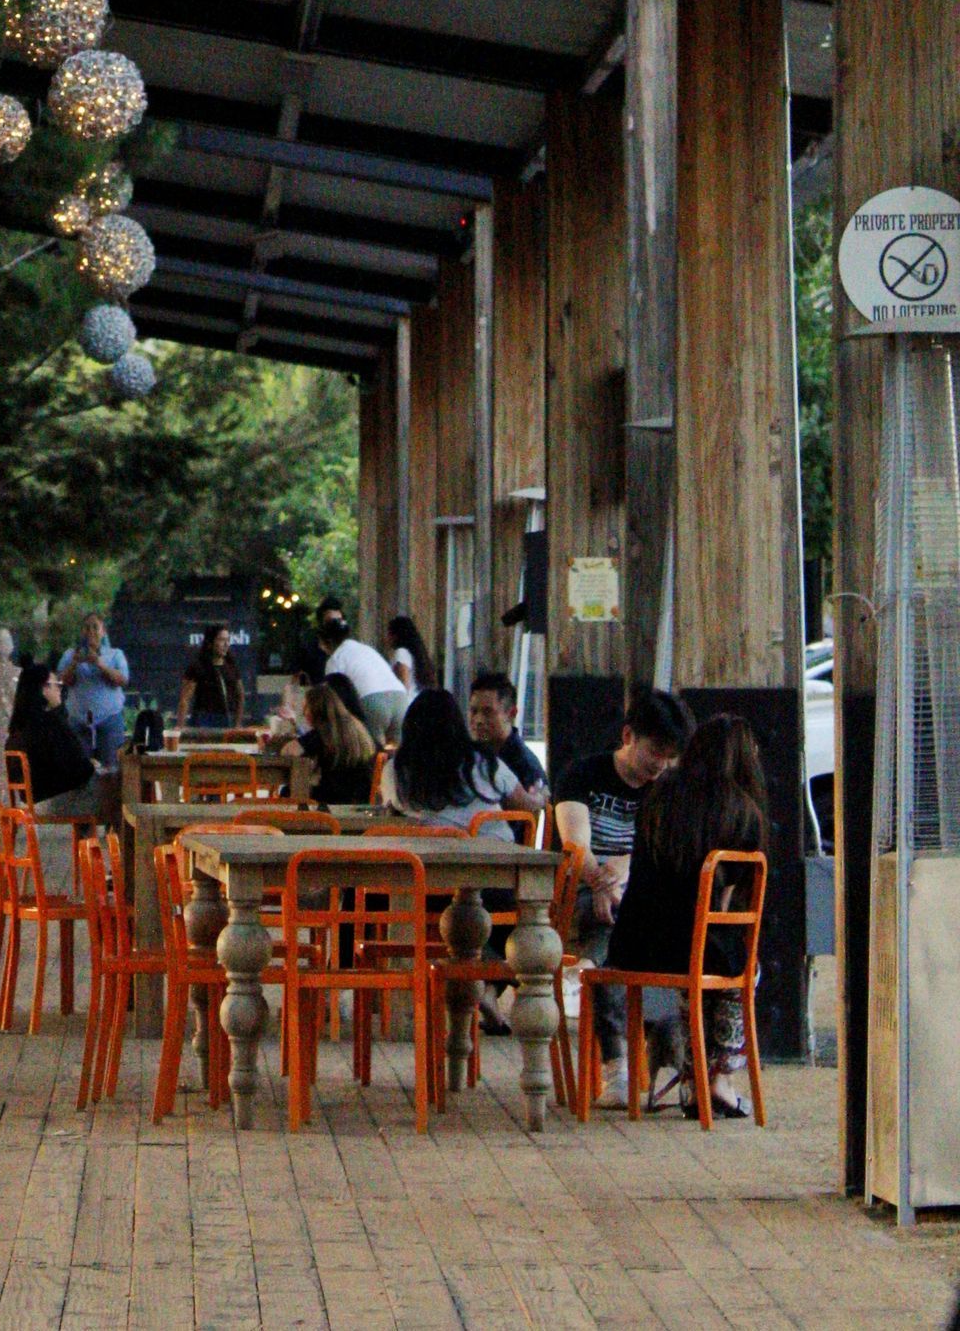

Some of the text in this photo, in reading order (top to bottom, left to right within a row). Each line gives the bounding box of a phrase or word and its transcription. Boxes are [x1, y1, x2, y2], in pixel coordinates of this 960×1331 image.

[854, 212, 960, 231] PRIVATE PROPERT
[873, 304, 957, 322] NO LOITERING
